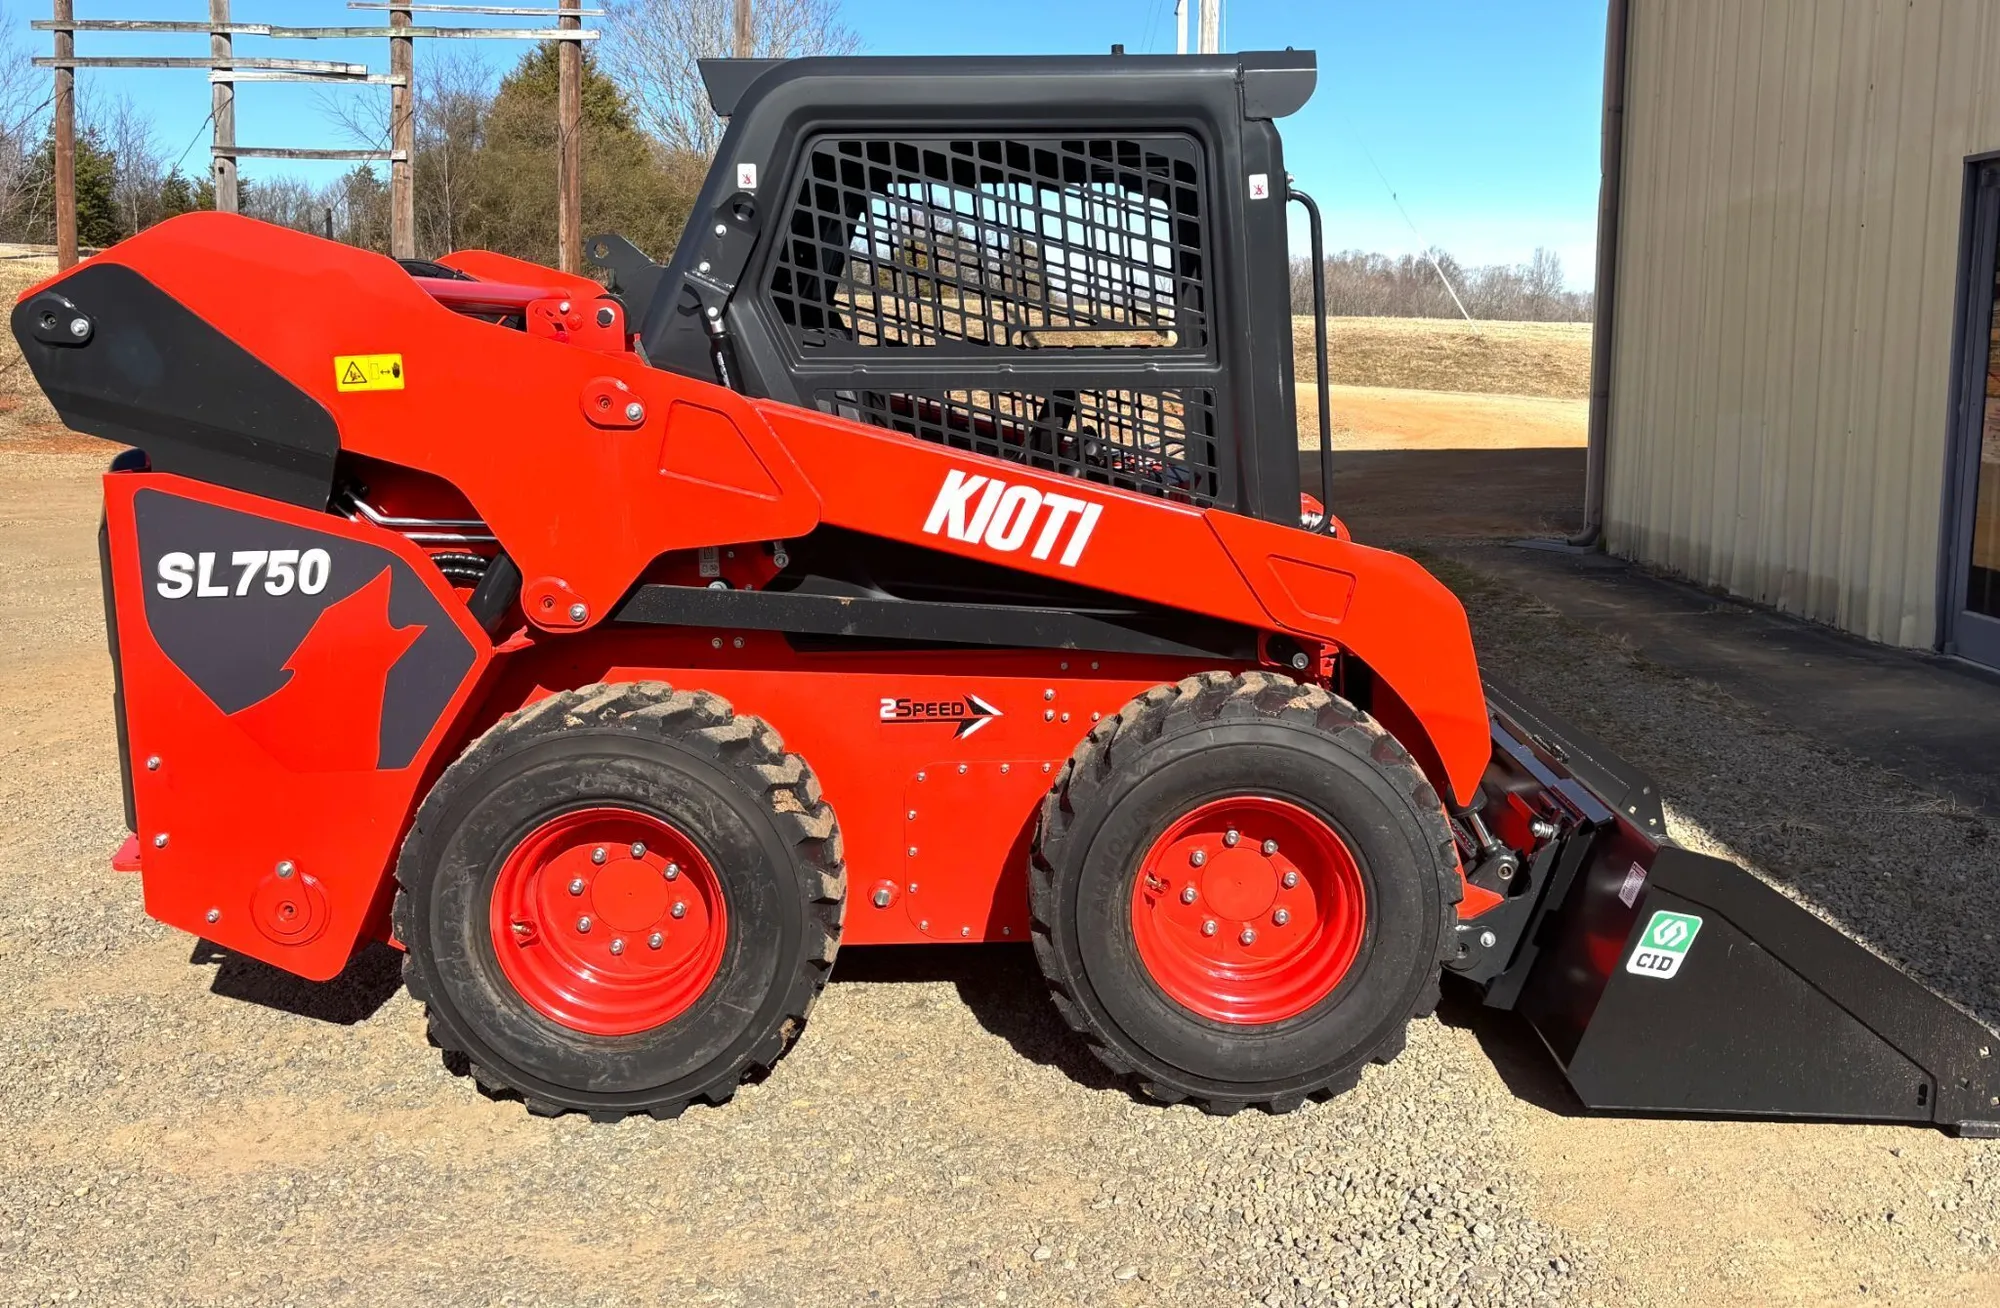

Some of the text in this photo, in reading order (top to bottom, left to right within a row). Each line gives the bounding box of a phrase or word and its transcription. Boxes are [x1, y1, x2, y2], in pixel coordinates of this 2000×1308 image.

[922, 468, 1104, 568] KIOTI
[156, 547, 332, 599] SL750
[1636, 953, 1674, 972] CID
